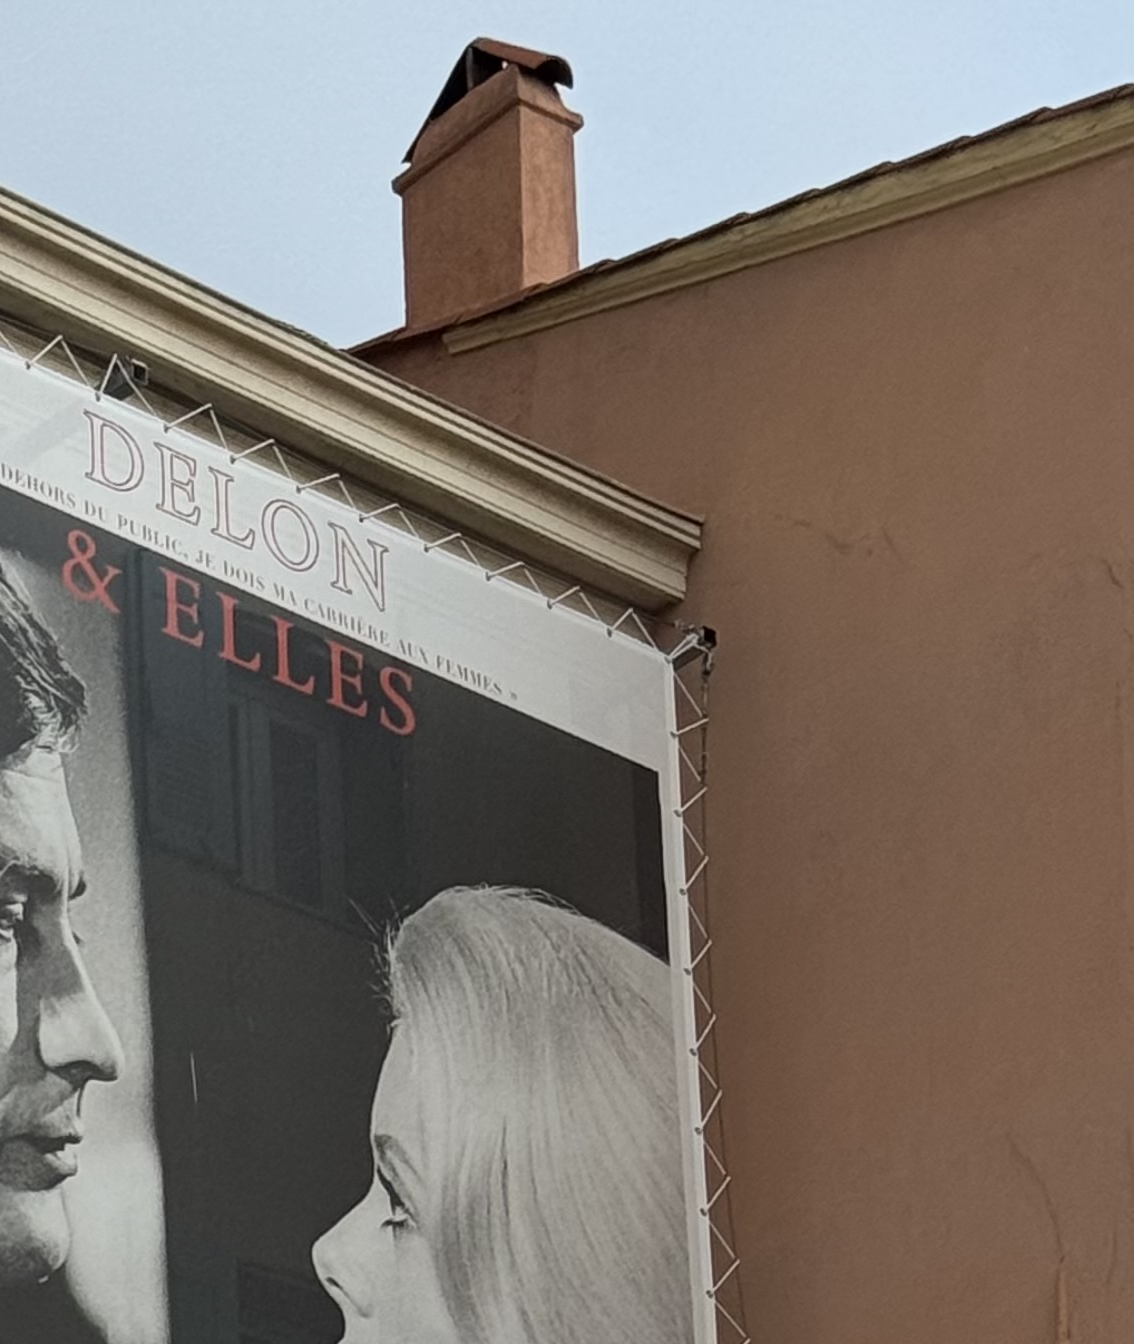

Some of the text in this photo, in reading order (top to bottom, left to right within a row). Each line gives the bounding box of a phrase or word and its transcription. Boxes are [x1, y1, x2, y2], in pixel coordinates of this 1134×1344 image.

[0, 462, 77, 509] DEHORS
[83, 499, 109, 522] DU
[195, 549, 216, 571] JE
[223, 560, 266, 592] DOIS
[273, 582, 298, 606] MA
[398, 639, 429, 665] AUX
[436, 654, 503, 696] FEMMES
[83, 408, 389, 612] DELON
[61, 528, 418, 737] & ELLES
